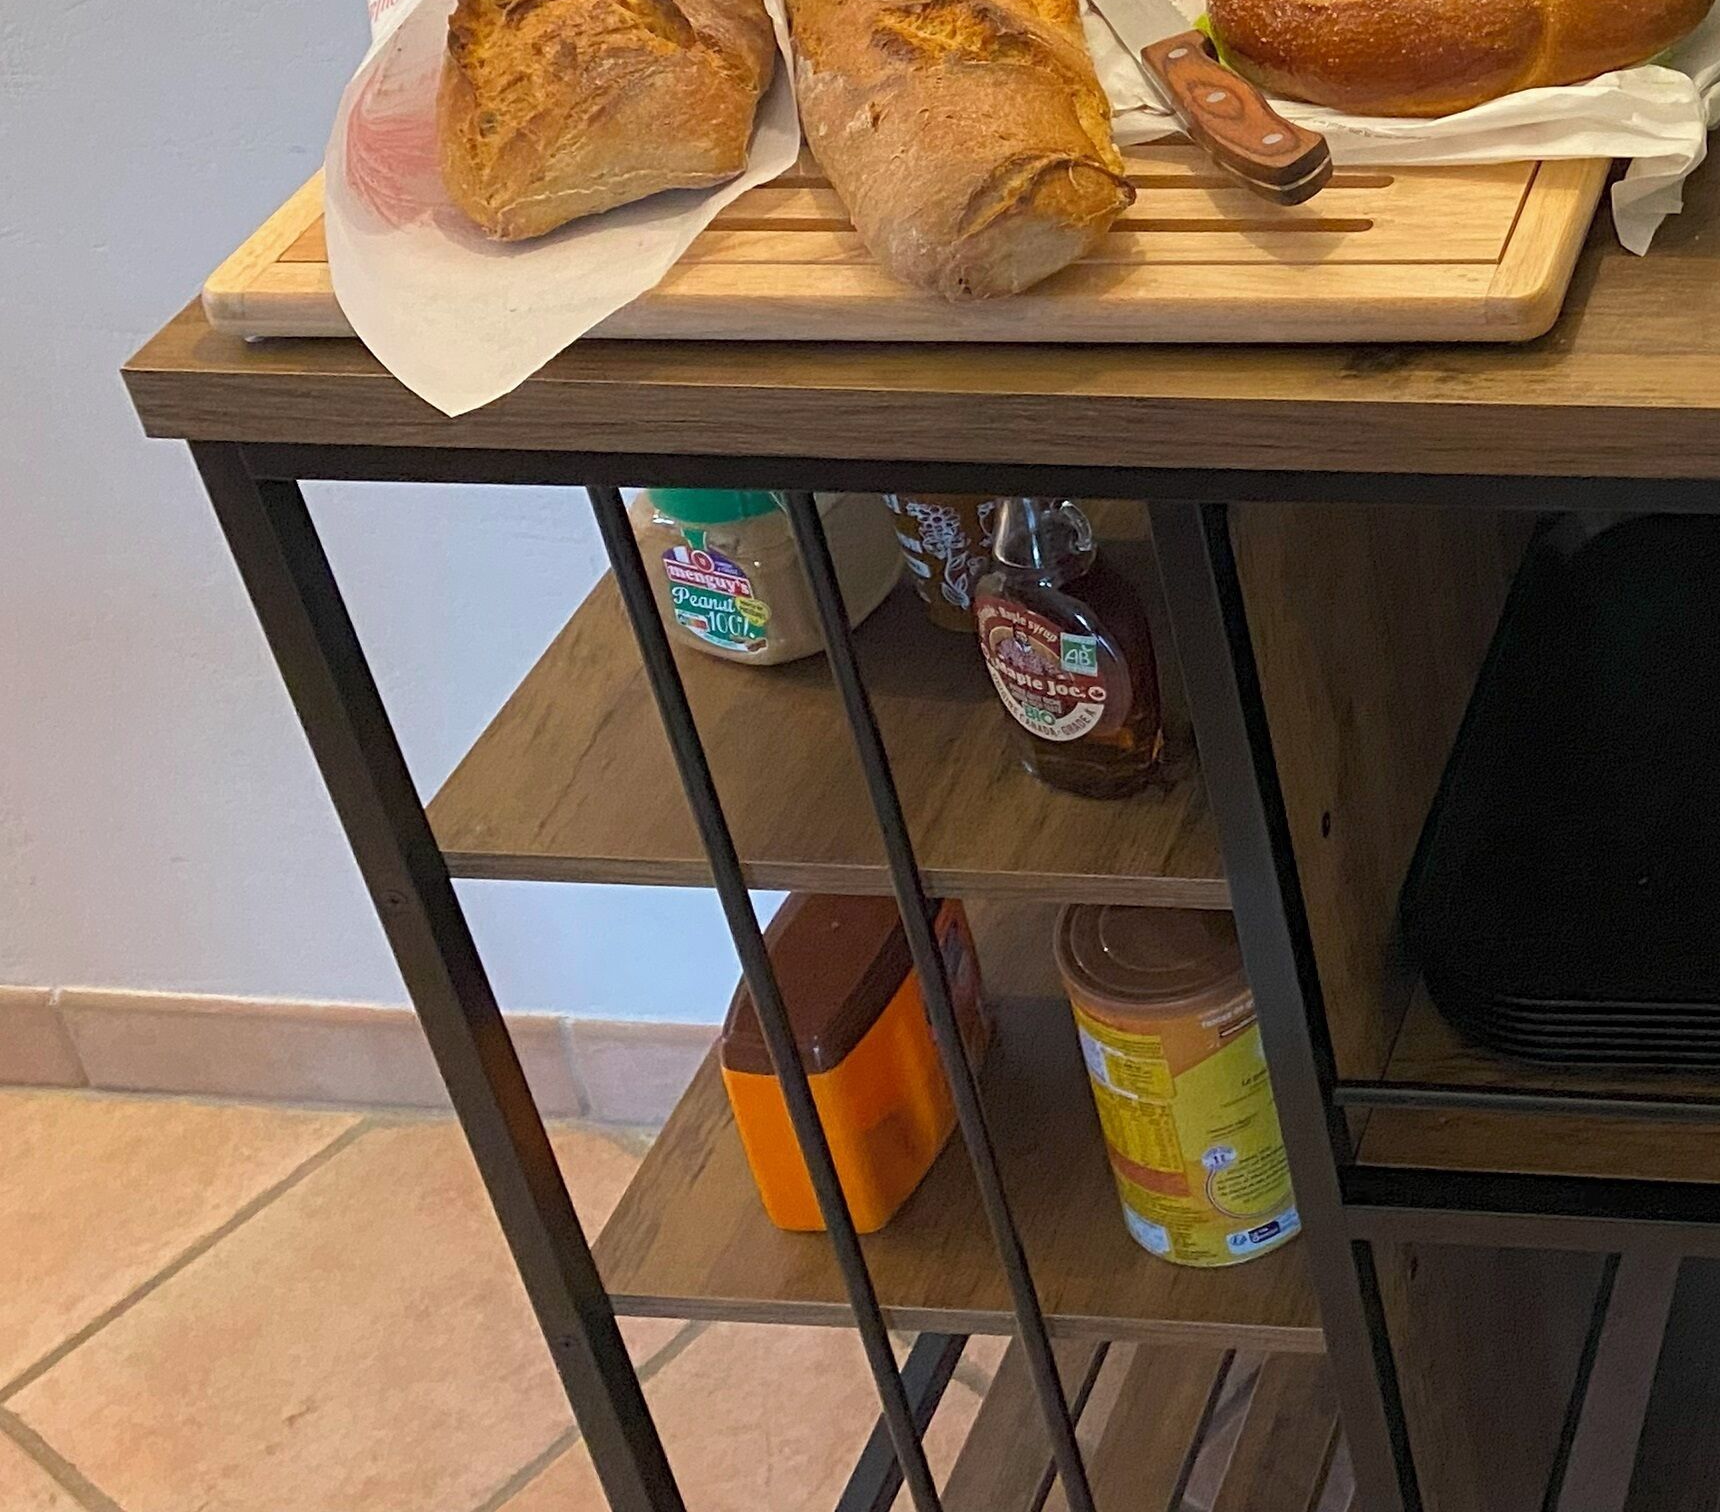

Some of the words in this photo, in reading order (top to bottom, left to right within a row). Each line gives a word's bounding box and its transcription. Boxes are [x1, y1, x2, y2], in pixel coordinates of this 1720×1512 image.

[668, 565, 750, 595] menguy's
[672, 586, 735, 612] Peanut
[1022, 702, 1057, 726] BIO
